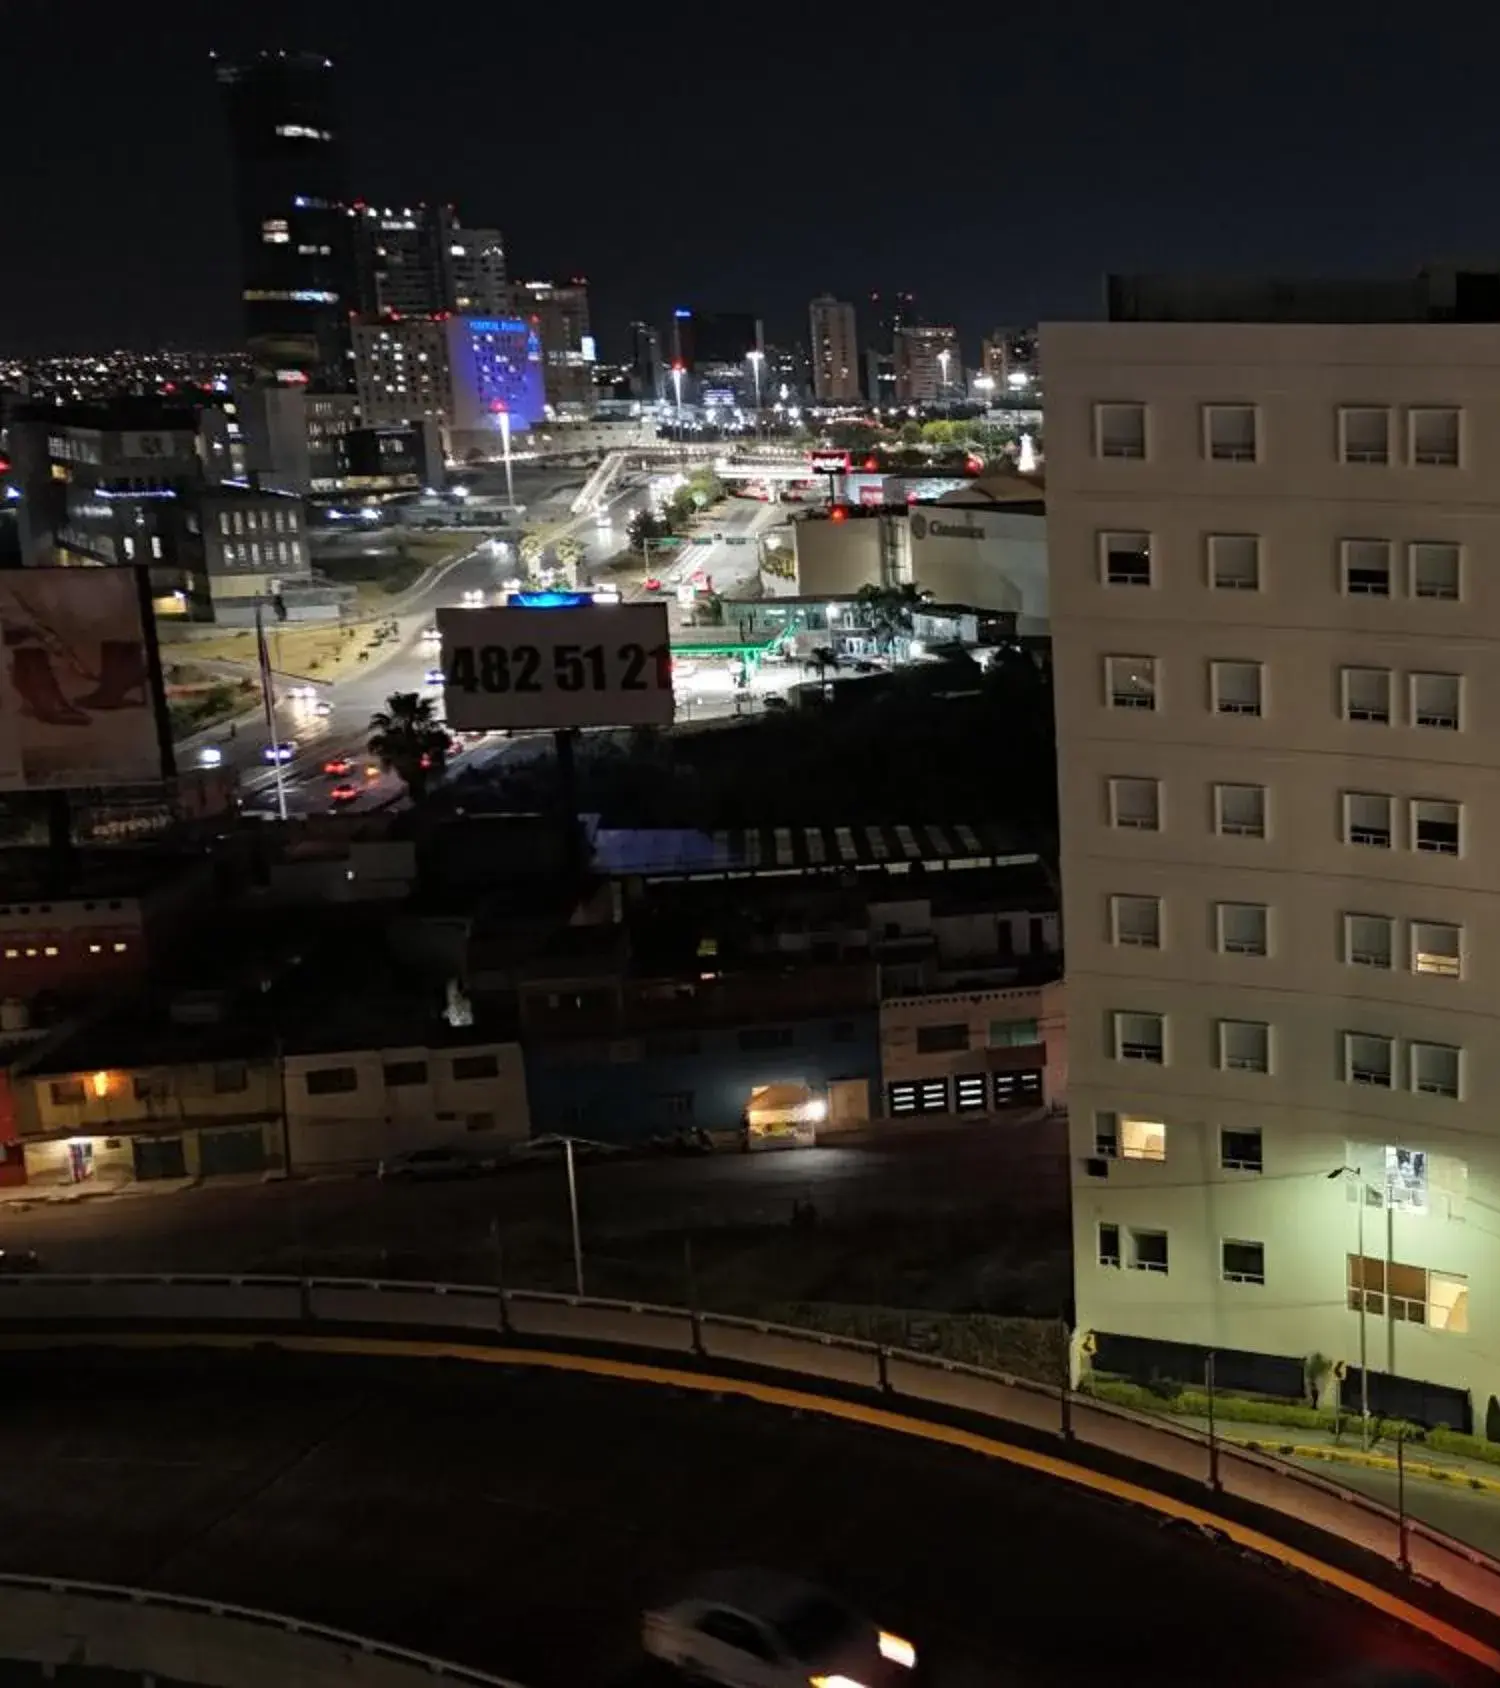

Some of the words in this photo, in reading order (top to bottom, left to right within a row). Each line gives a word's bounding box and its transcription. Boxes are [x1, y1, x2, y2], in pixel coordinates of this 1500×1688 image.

[450, 645, 542, 693] 482
[553, 644, 607, 691] 51
[617, 643, 673, 691] 21
